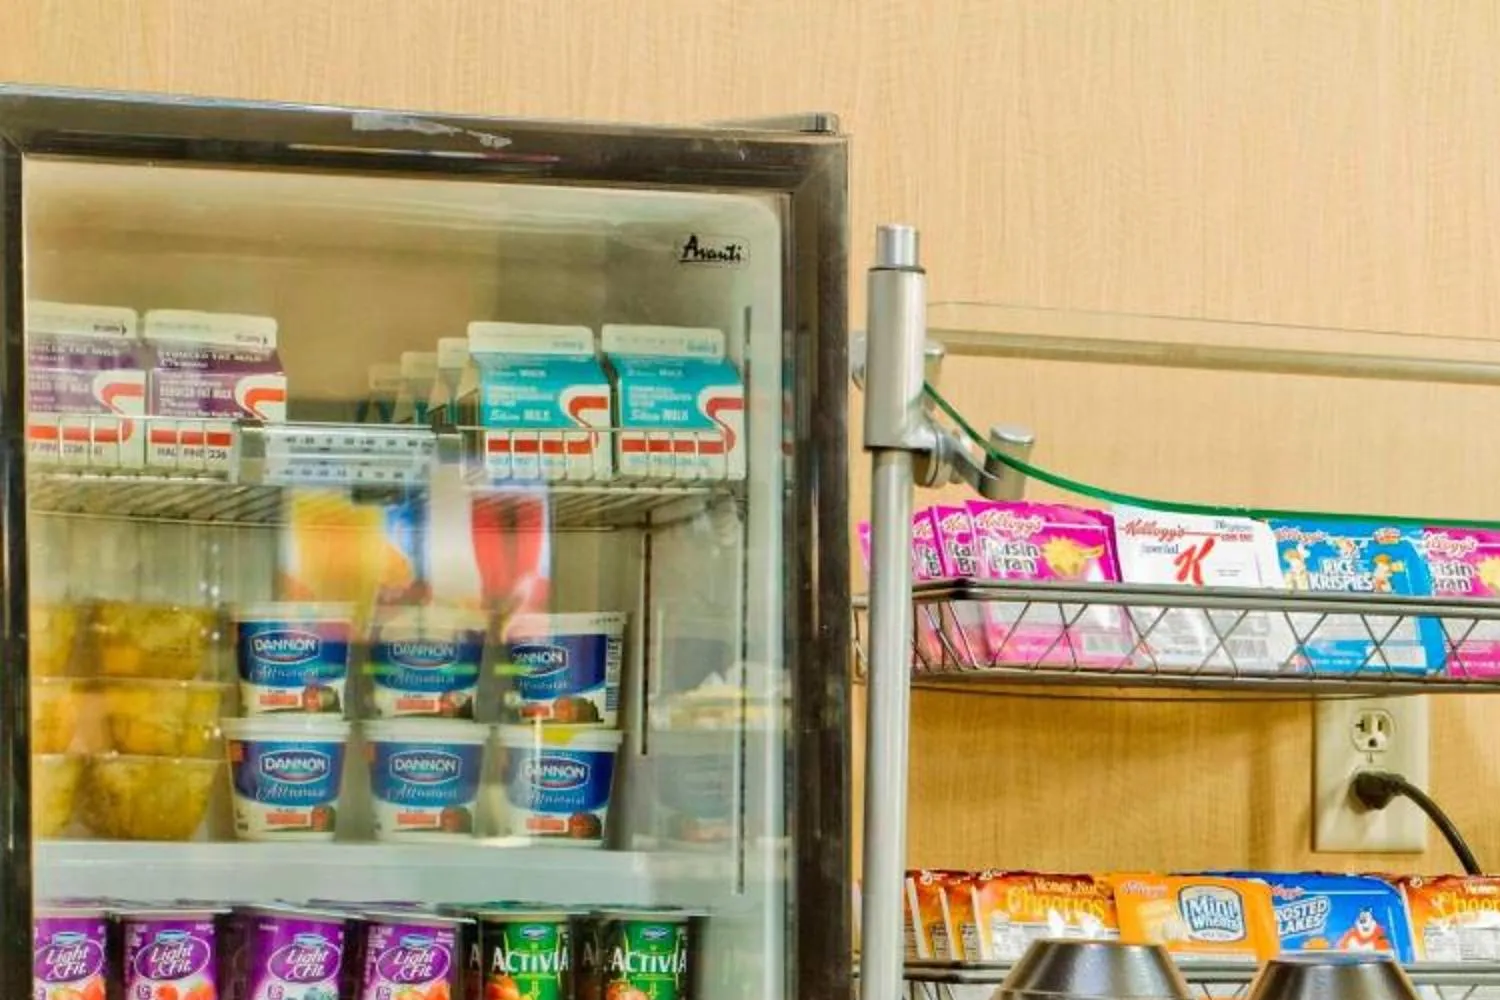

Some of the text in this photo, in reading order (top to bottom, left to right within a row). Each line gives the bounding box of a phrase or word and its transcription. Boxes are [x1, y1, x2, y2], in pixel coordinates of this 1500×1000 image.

[254, 638, 316, 653] DANNON
[392, 641, 455, 657] DANNON
[264, 756, 325, 773] DANNON
[394, 757, 456, 773] DANNON
[45, 943, 89, 967] Light
[151, 943, 194, 966] Light
[286, 947, 328, 970] Light
[393, 948, 435, 970] Light
[491, 946, 569, 975] ACTIVIA
[611, 946, 687, 975] ACTIVIA
